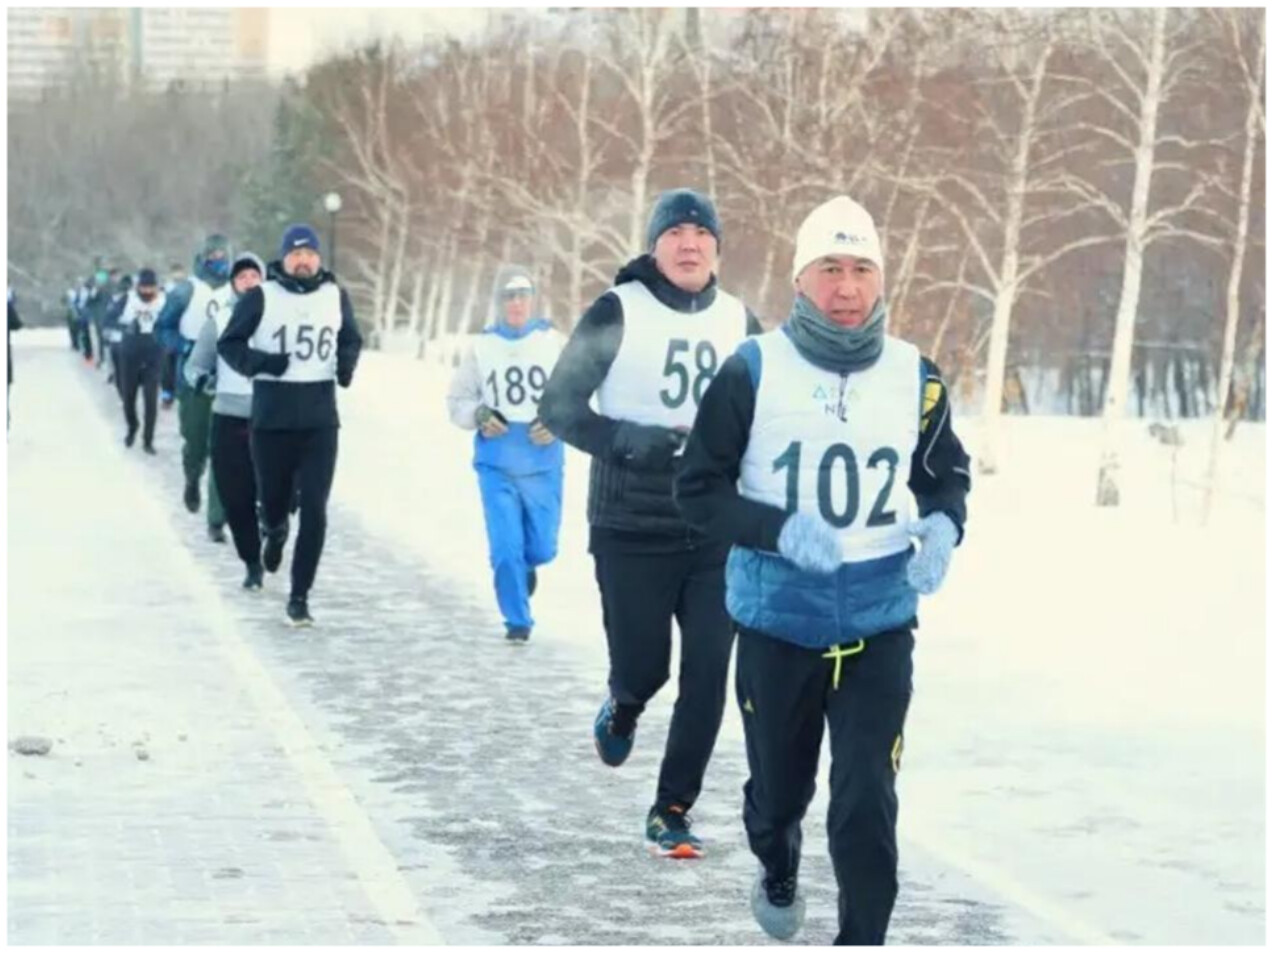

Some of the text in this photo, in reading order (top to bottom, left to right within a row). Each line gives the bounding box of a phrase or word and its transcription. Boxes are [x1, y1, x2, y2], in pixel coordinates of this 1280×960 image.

[272, 324, 334, 362] 156
[485, 364, 548, 408] 189
[659, 338, 718, 410] 58
[771, 440, 900, 529] 102
